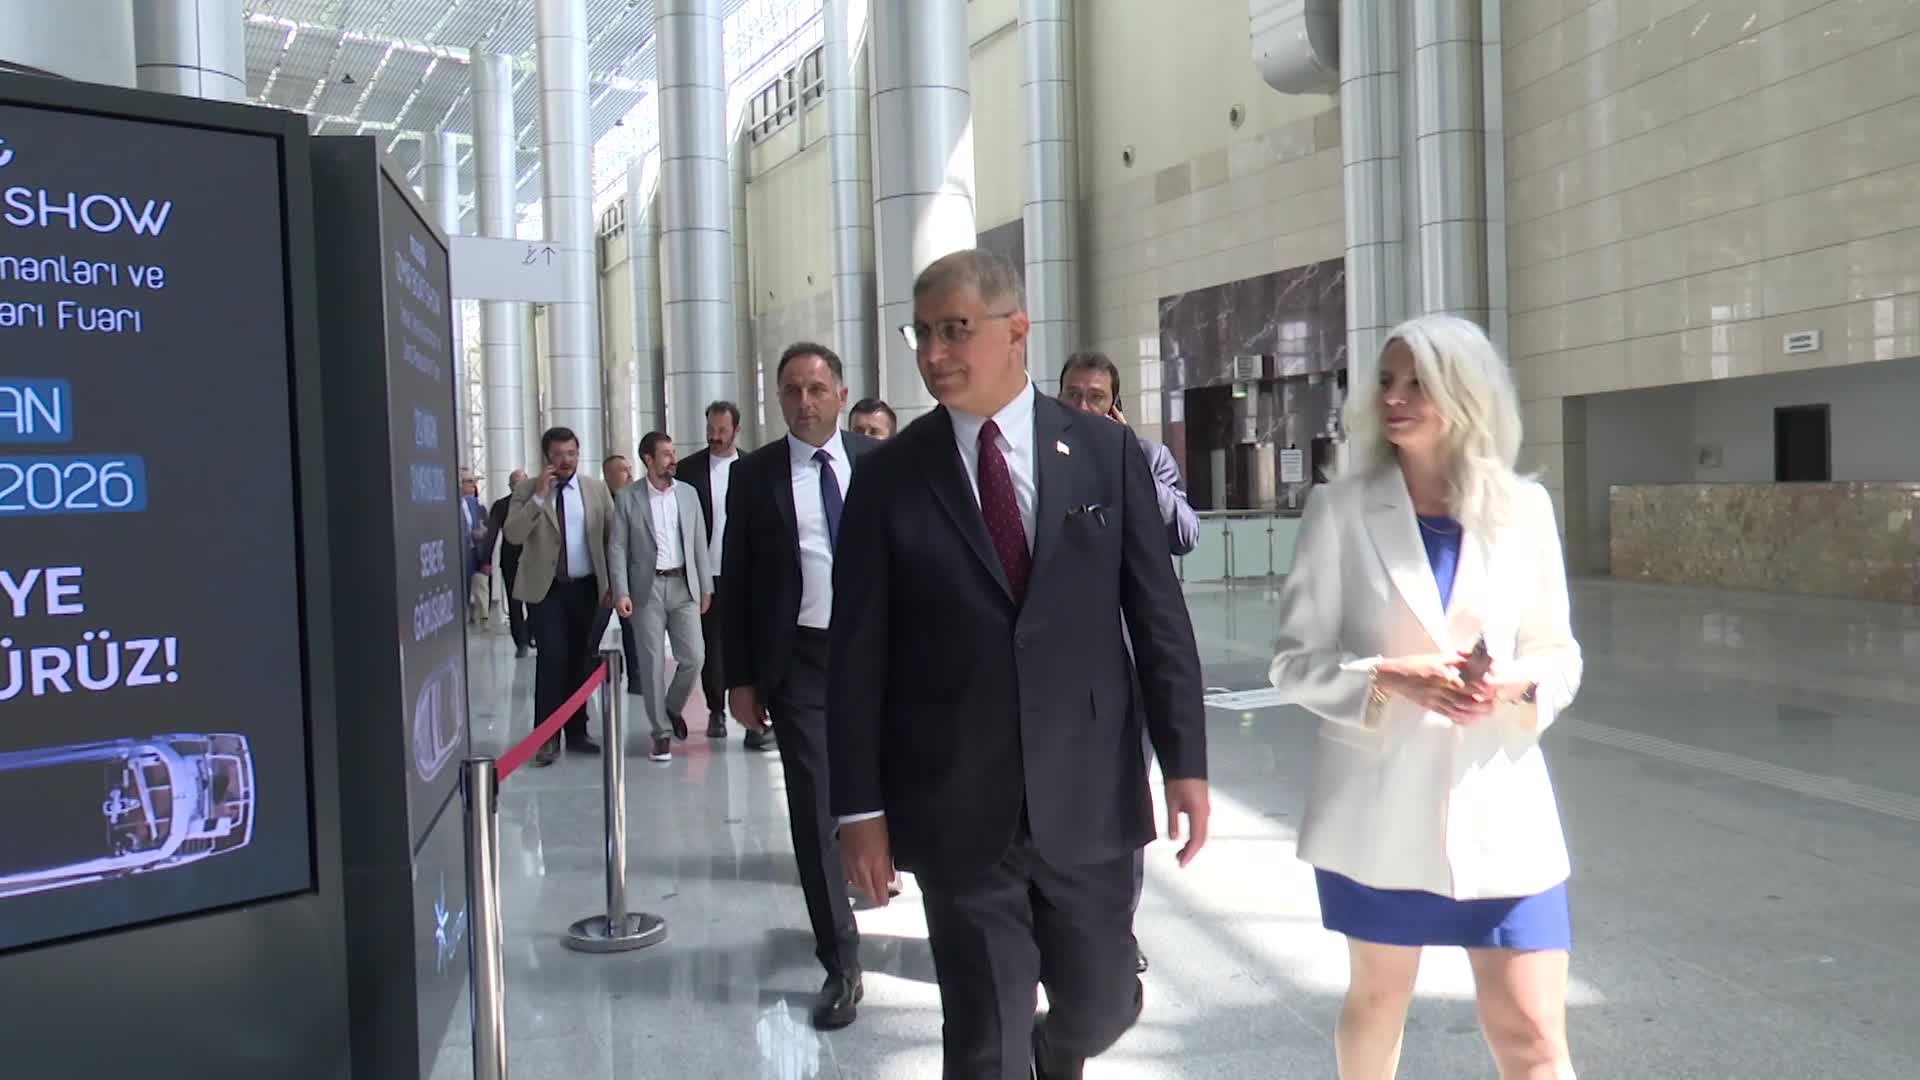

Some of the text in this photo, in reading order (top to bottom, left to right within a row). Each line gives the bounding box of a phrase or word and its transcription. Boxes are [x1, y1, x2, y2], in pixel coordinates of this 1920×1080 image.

[4, 186, 172, 237] SHOW
[127, 265, 165, 289] ve
[57, 300, 142, 332] Fuarı
[0, 461, 133, 510] 2026
[0, 567, 84, 617] YE
